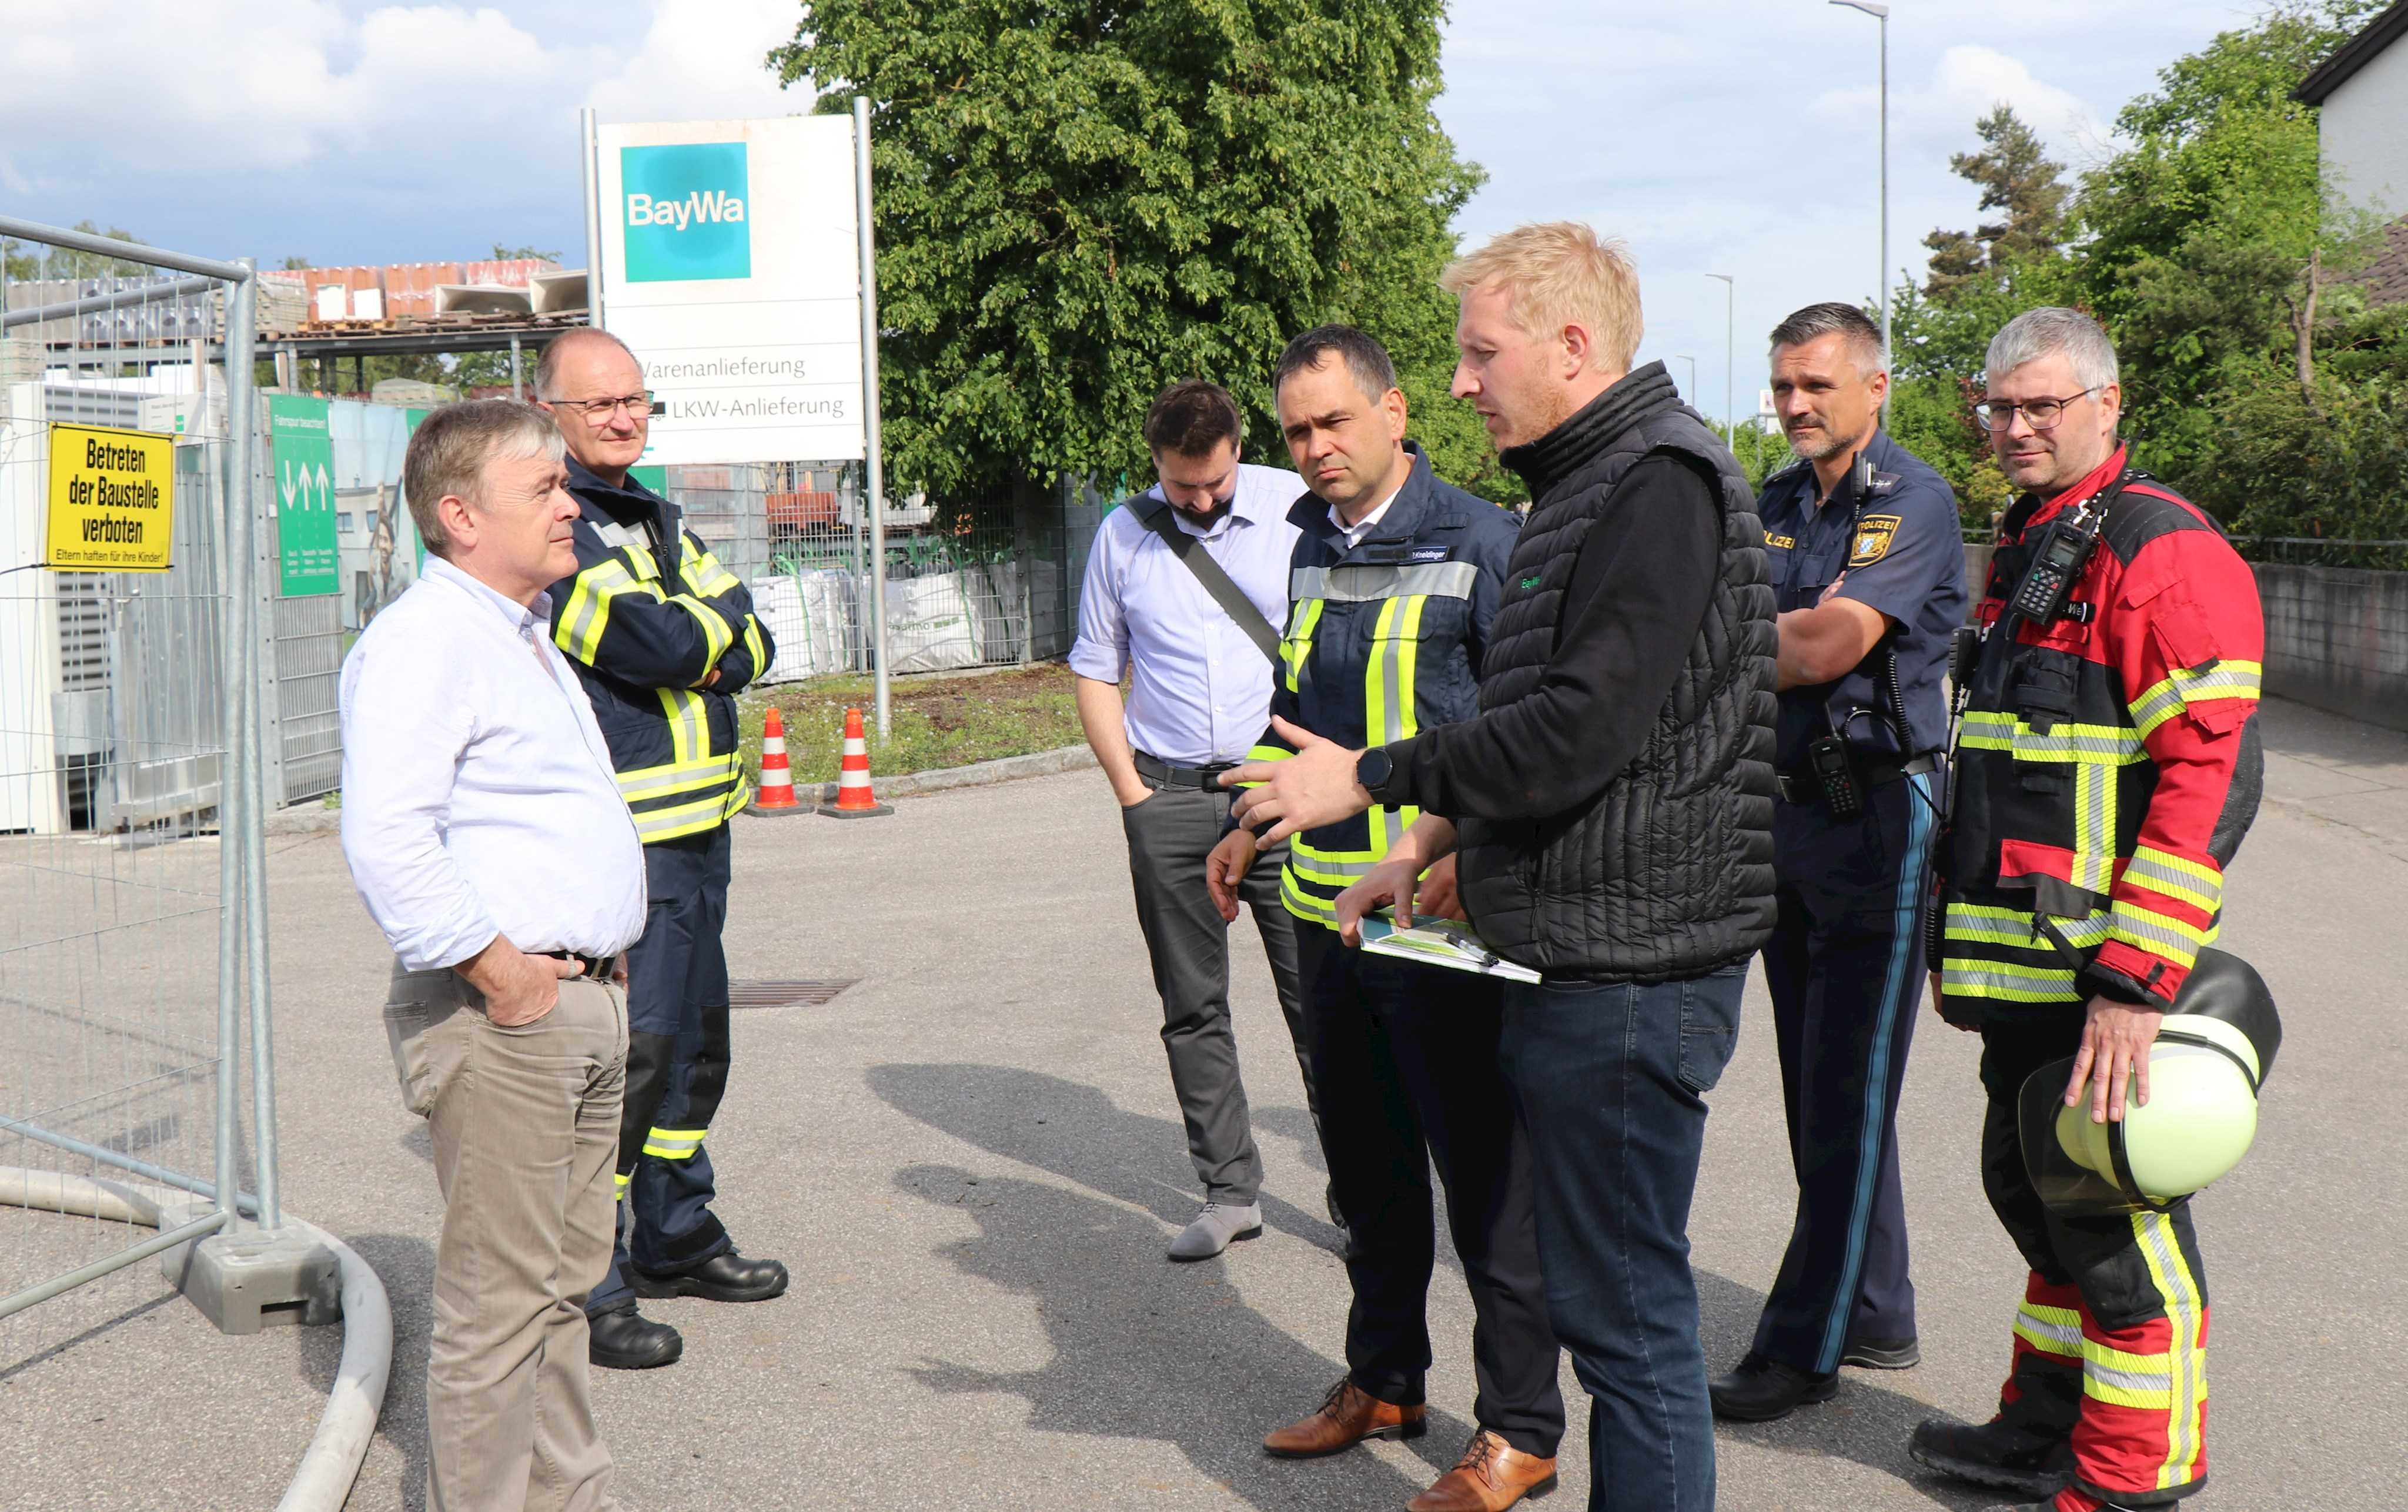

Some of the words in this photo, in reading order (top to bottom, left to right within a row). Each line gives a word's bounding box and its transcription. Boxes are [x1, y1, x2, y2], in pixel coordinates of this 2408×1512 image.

[627, 190, 744, 231] BayWa
[673, 396, 844, 419] LKW-Anlieferung
[86, 438, 146, 473] Betreten
[69, 474, 95, 505] der
[98, 476, 159, 509] Baustelle
[82, 513, 143, 544] verboten
[1860, 520, 1895, 531] POLIZEI
[1763, 530, 1796, 550] LIZEI
[56, 548, 81, 560] Eltern
[83, 550, 108, 561] haften
[110, 550, 121, 562] für
[122, 550, 136, 563] ihre
[138, 551, 163, 563] Kinder!
